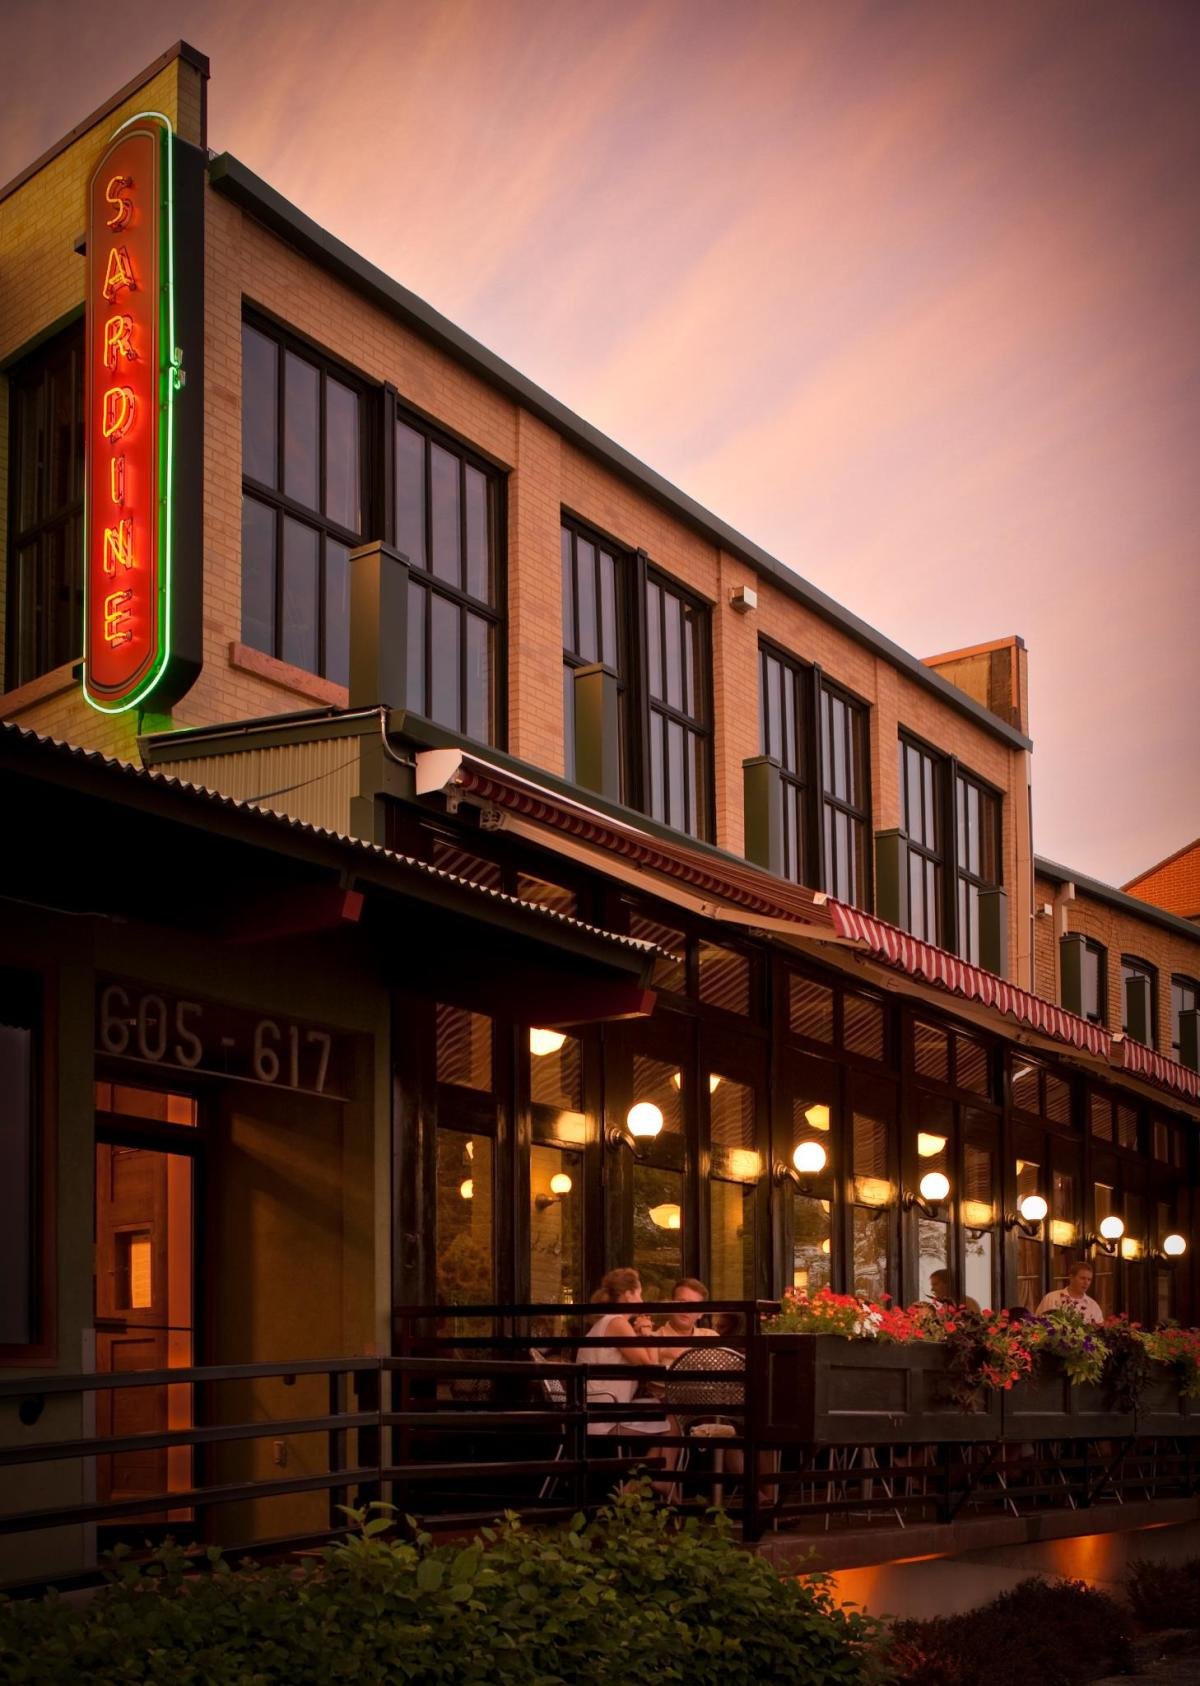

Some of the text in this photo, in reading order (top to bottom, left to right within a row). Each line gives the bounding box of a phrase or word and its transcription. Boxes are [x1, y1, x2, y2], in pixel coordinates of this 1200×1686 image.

[102, 175, 138, 649] SARDINE
[101, 986, 203, 1068] 605
[255, 1020, 331, 1094] 617
